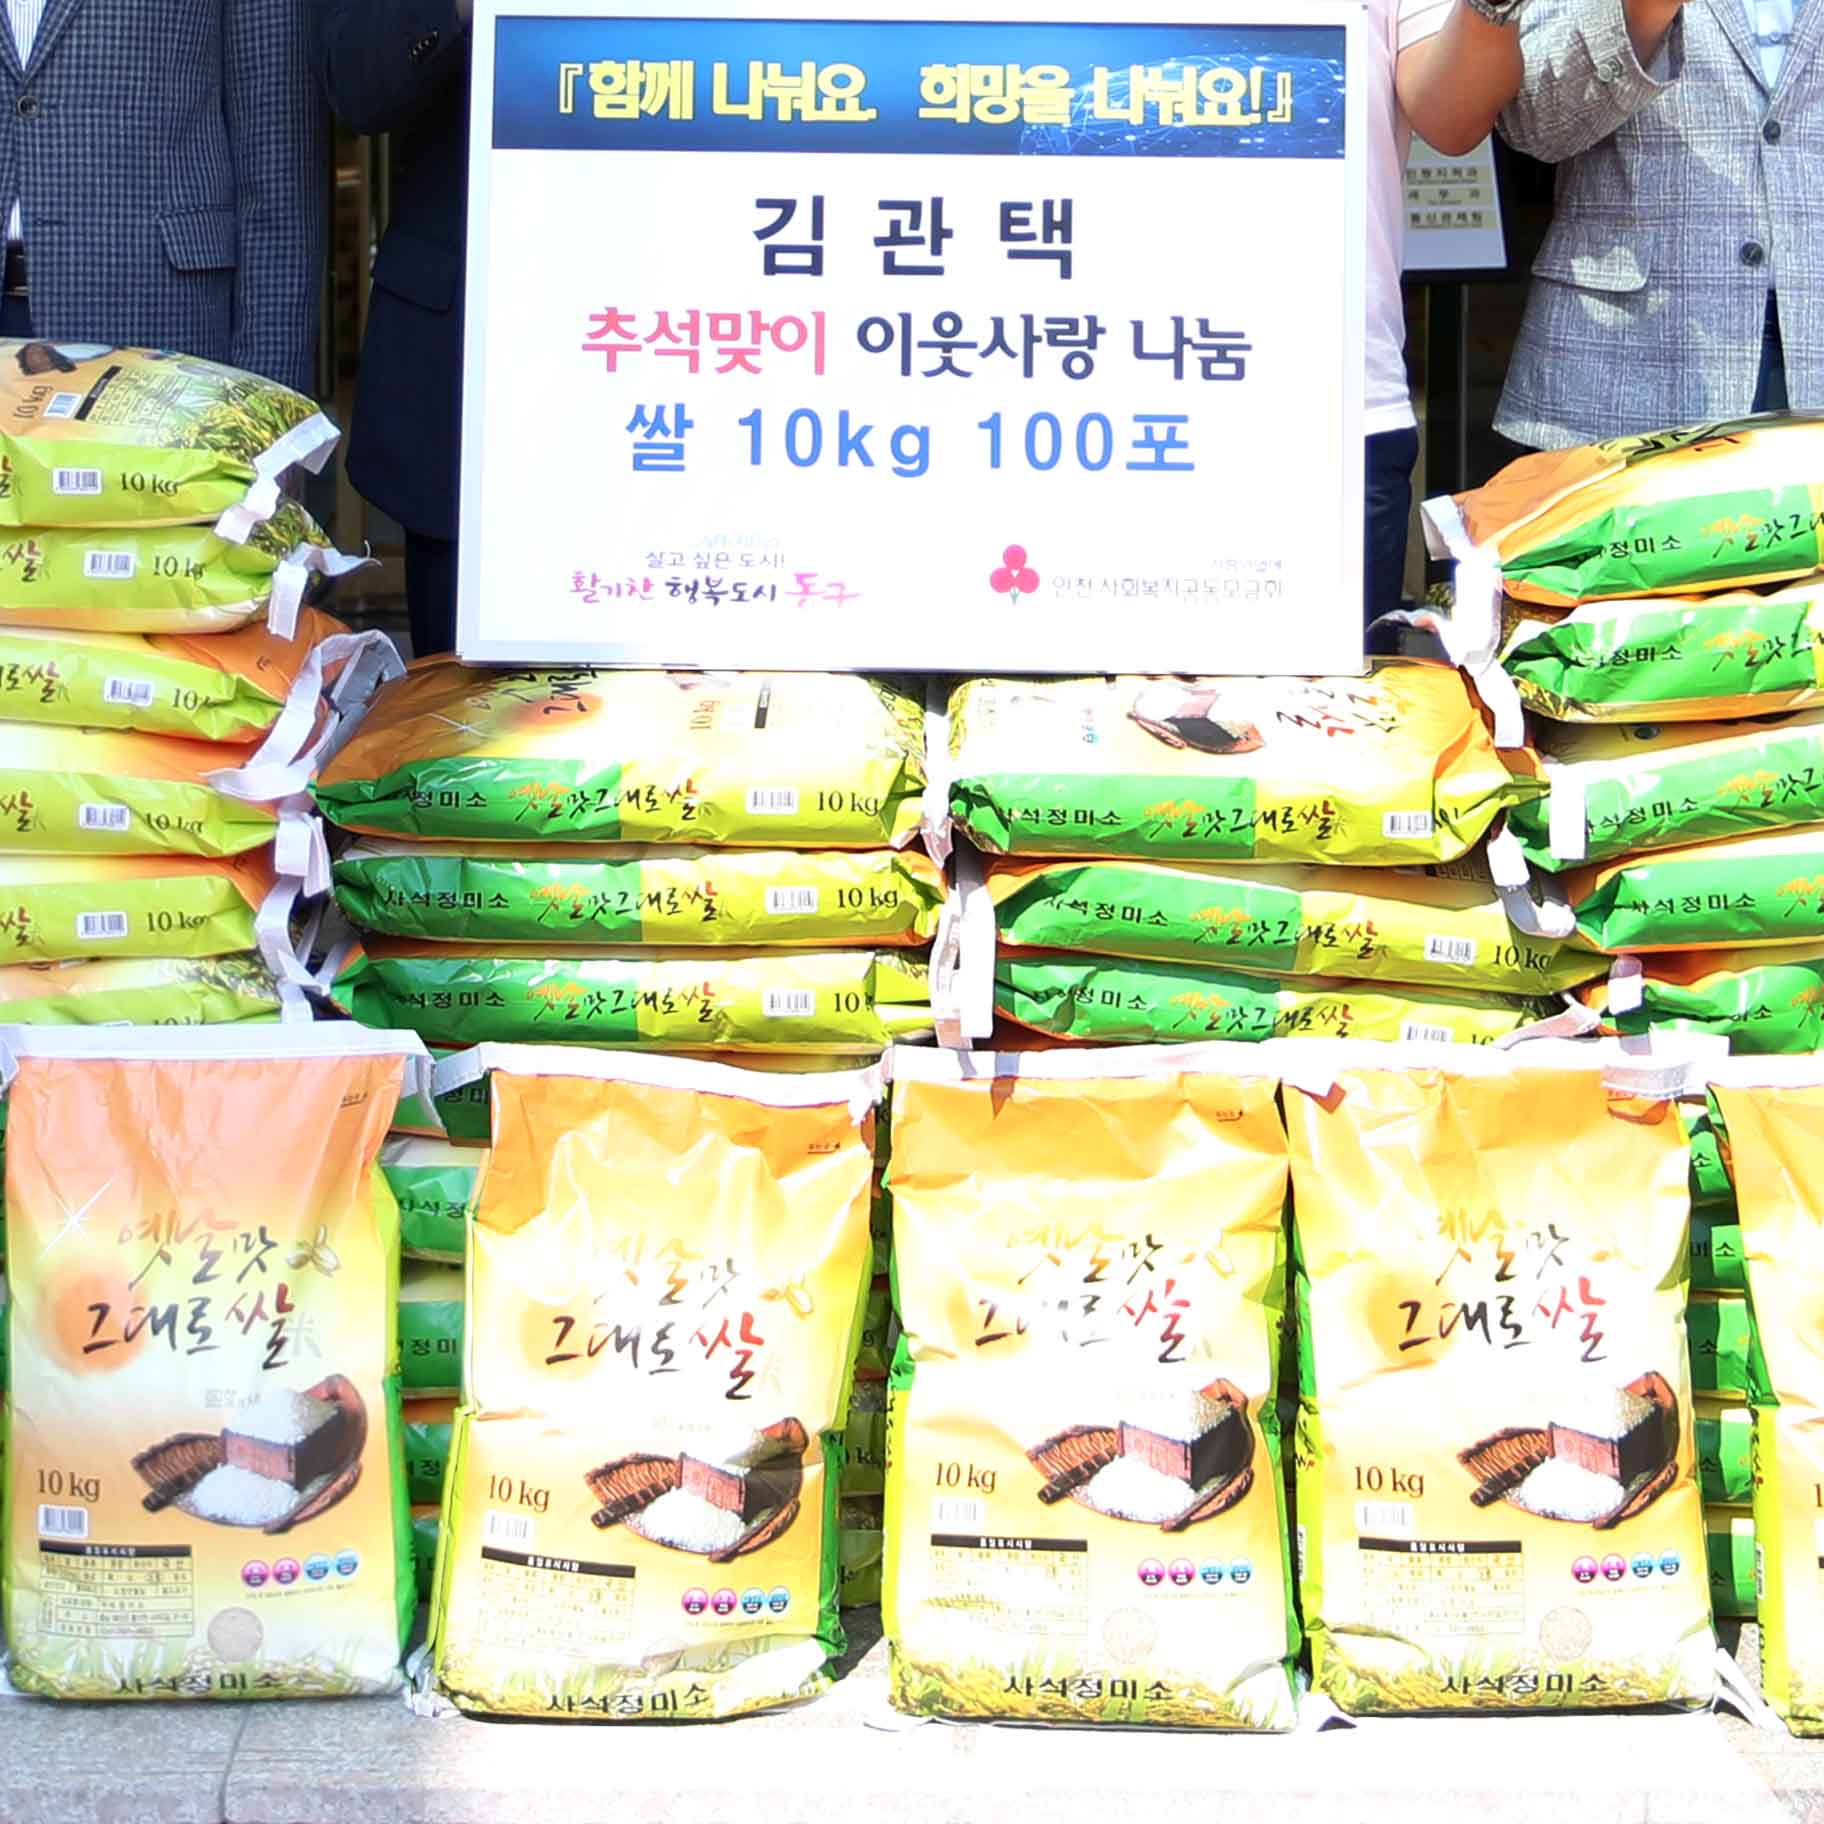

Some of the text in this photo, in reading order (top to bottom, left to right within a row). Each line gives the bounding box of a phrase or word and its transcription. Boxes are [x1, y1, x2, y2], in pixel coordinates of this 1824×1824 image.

[918, 63, 1072, 126] 희망을
[581, 306, 1253, 382] 추석맞이 이웃사랑 나눔
[625, 401, 1197, 478] 쌀 10kg 100포
[119, 472, 178, 497] 10 kg
[644, 550, 785, 570] 살고 싶은 도시!
[568, 570, 864, 609] 활기찬 행복도시 동구
[817, 793, 879, 819] 10 kg
[838, 887, 898, 912] 10 kg
[38, 1470, 100, 1503] 10 kg
[488, 1474, 550, 1513] 10 kg
[935, 1462, 997, 1495] 10 kg
[1355, 1467, 1424, 1497] 10 kg
